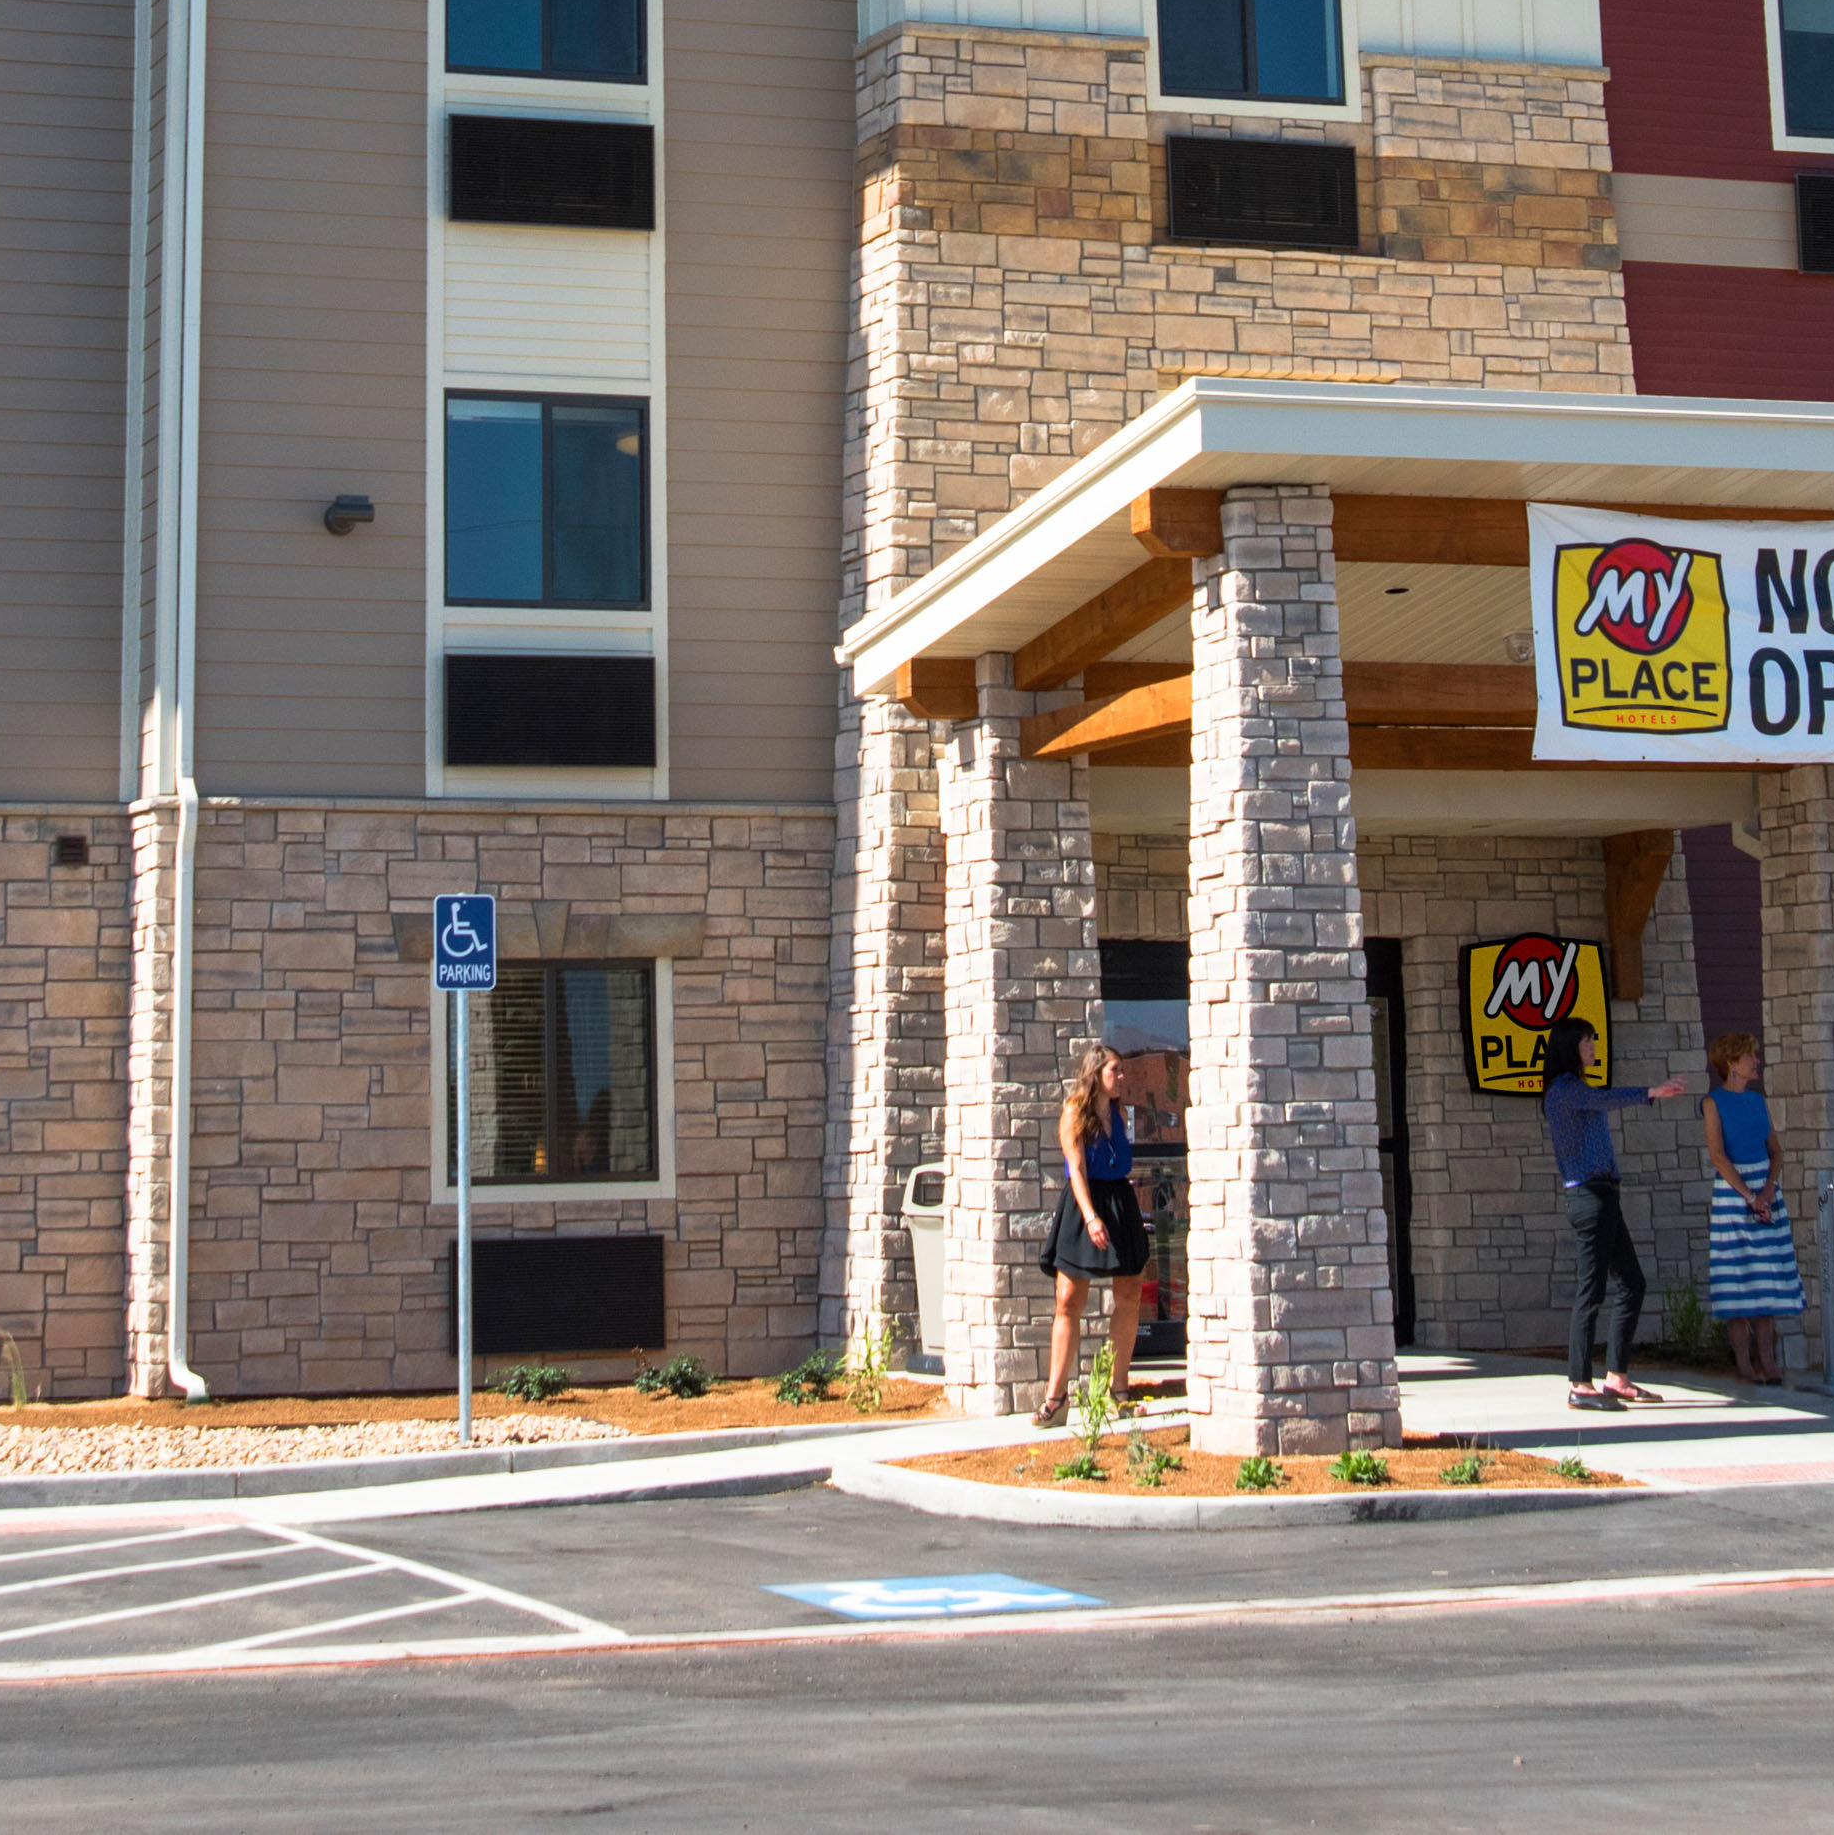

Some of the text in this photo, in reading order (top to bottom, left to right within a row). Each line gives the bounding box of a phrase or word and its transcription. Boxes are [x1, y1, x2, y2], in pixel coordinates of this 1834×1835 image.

[1570, 657, 1719, 702] PLACE
[1616, 714, 1678, 725] HOTELS
[439, 963, 492, 982] PARKING
[1480, 1033, 1602, 1069] PLA
